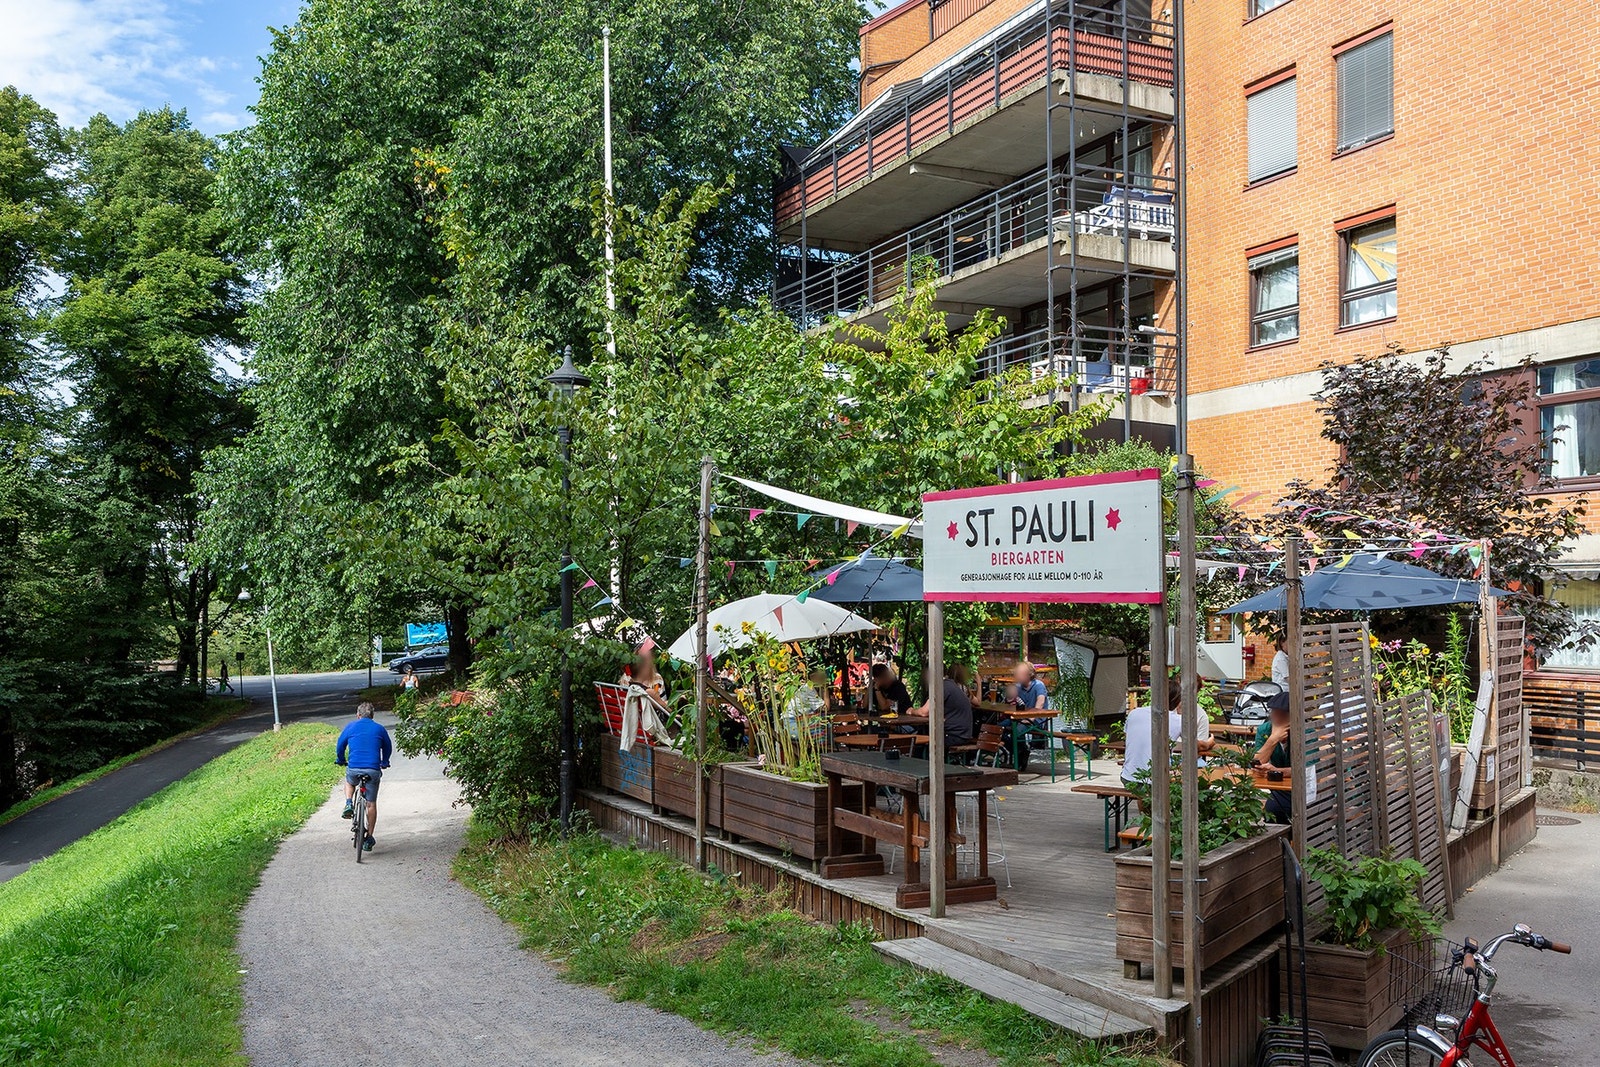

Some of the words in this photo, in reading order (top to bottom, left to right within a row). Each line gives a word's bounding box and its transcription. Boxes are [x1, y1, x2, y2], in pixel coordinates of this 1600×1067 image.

[965, 508, 1001, 547] ST.
[1012, 500, 1095, 545] PAULI
[991, 550, 1064, 566] BIERGARTEN
[1013, 572, 1026, 581] FOR
[1027, 571, 1042, 580] ALLE
[1044, 571, 1071, 580] MELLOM
[1073, 571, 1091, 580] 0-110
[1093, 569, 1103, 580] ÅR
